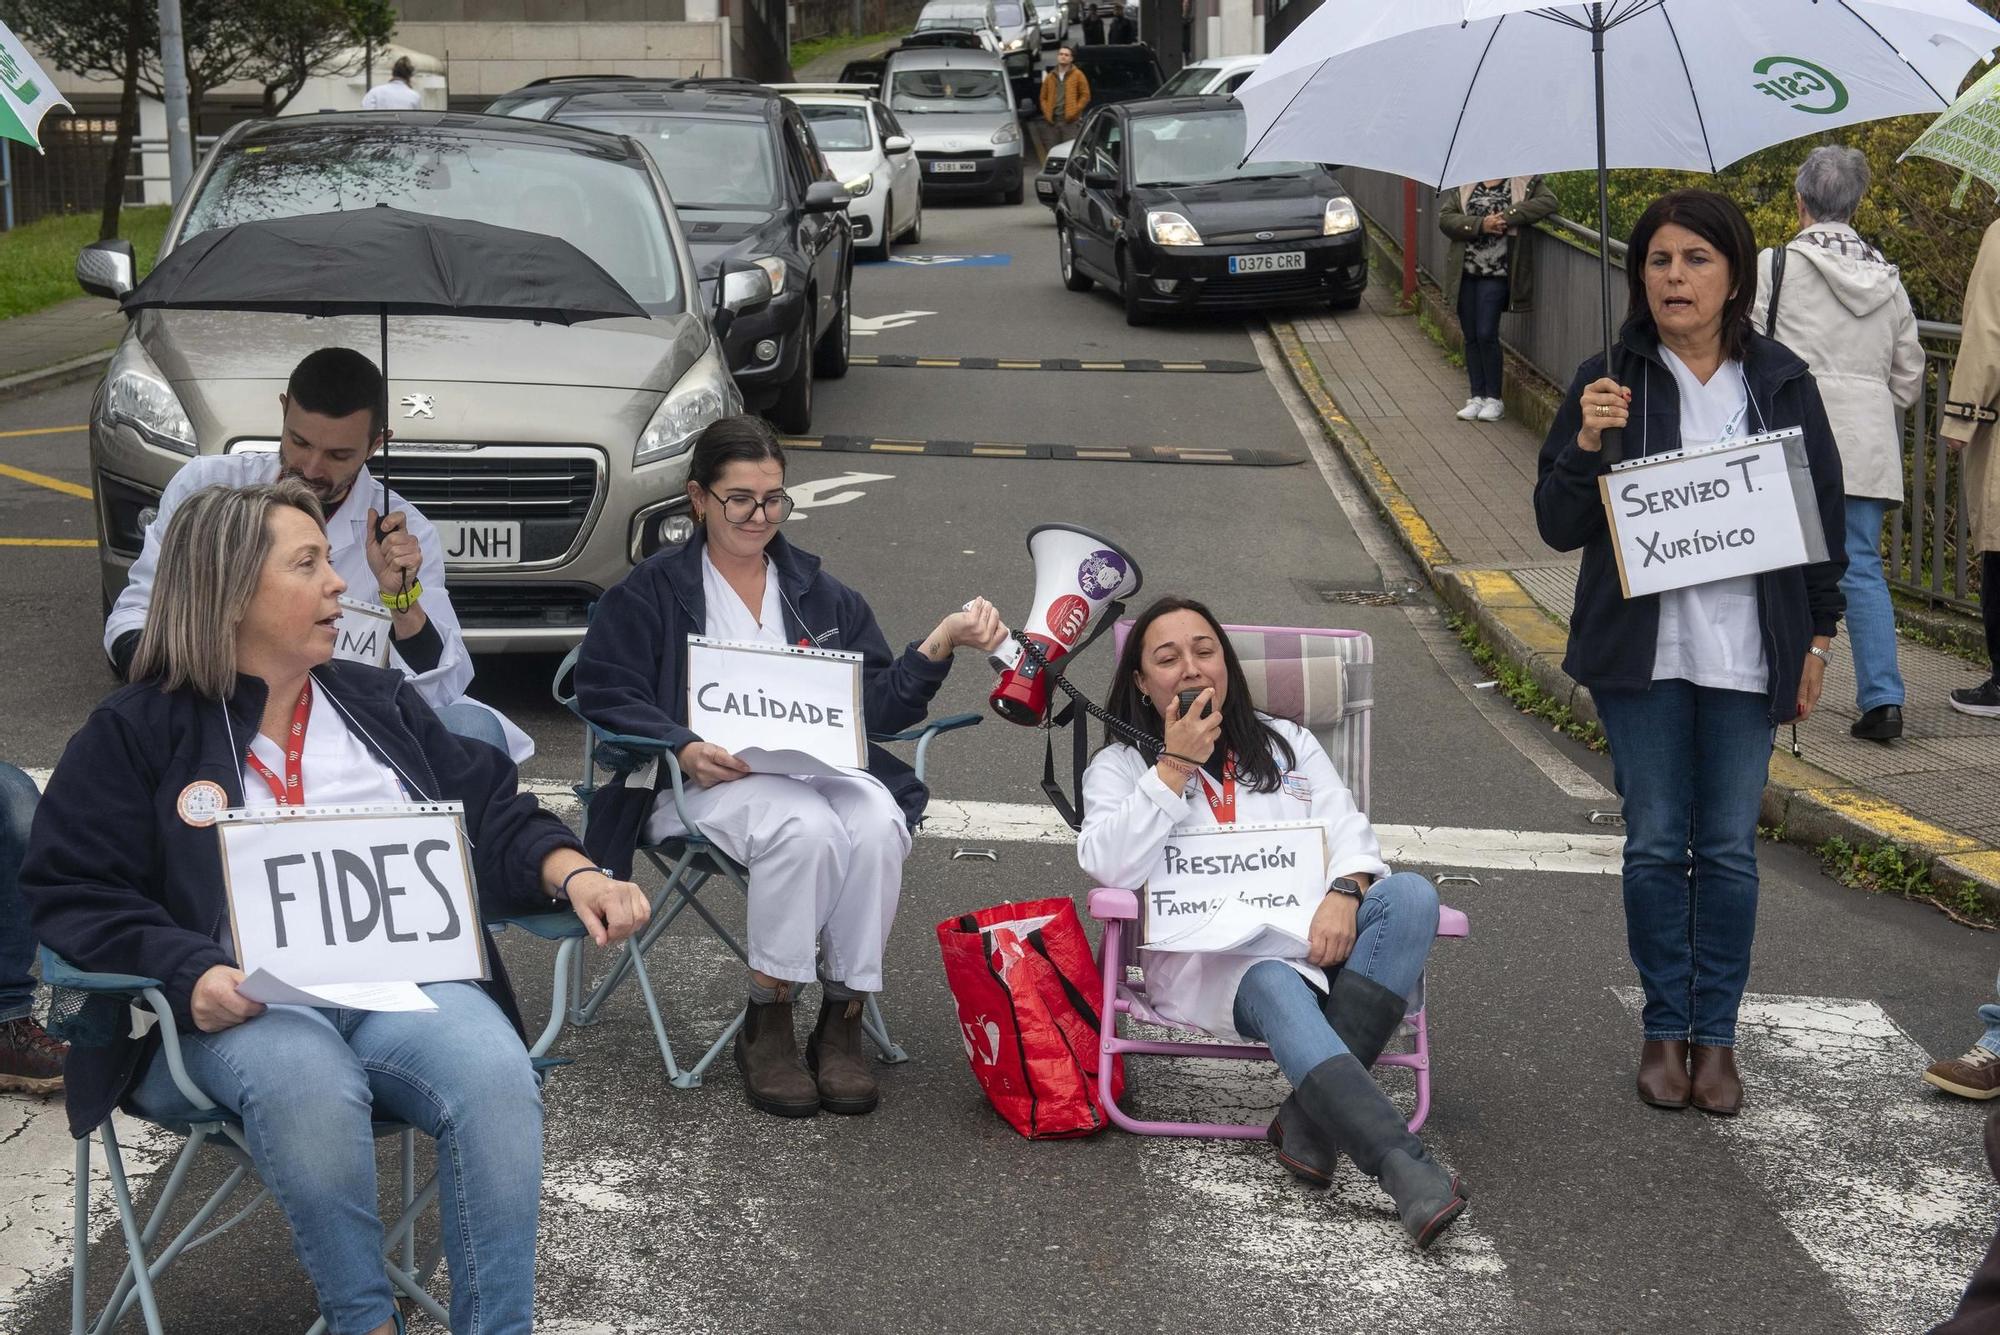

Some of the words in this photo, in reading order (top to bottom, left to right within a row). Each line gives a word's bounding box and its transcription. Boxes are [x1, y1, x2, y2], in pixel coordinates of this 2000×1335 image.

[1239, 256, 1273, 271] 0376
[1277, 254, 1302, 268] CRR
[1726, 454, 1762, 493] T.
[447, 527, 512, 558] JNH
[263, 839, 461, 948] FIDES
